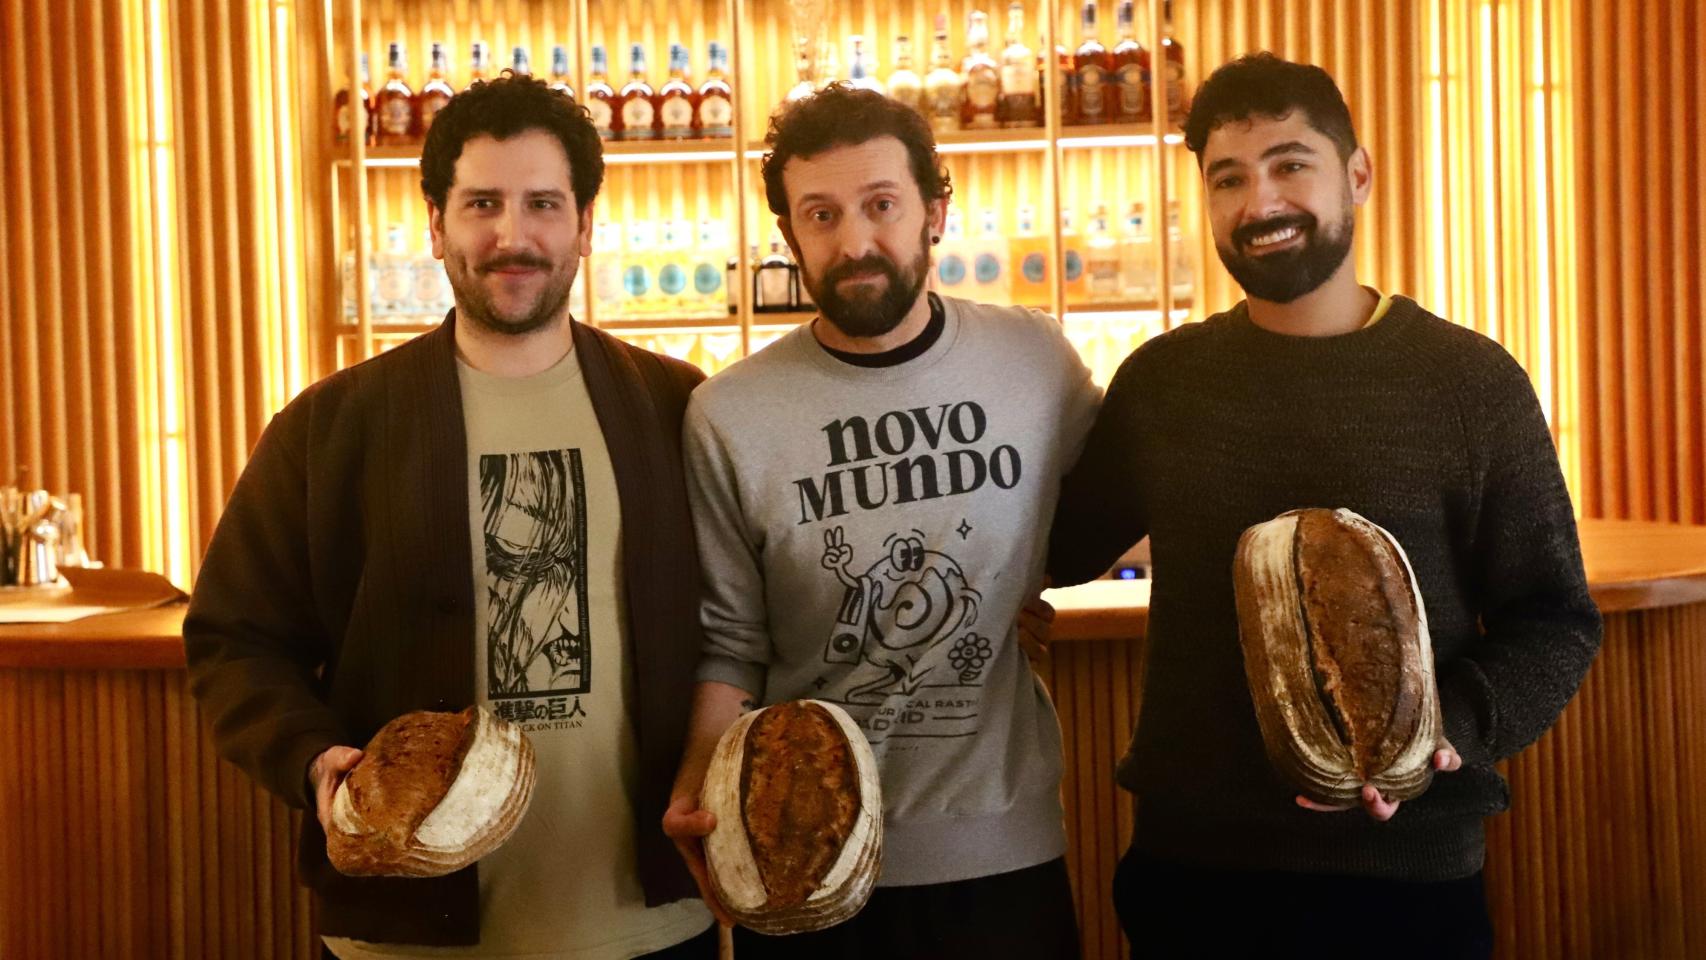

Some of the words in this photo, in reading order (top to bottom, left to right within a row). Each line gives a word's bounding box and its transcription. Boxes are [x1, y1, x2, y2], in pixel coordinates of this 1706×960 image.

[494, 696, 587, 722] 進撃の巨人
[537, 722, 552, 731] ON
[554, 720, 584, 730] TITAN
